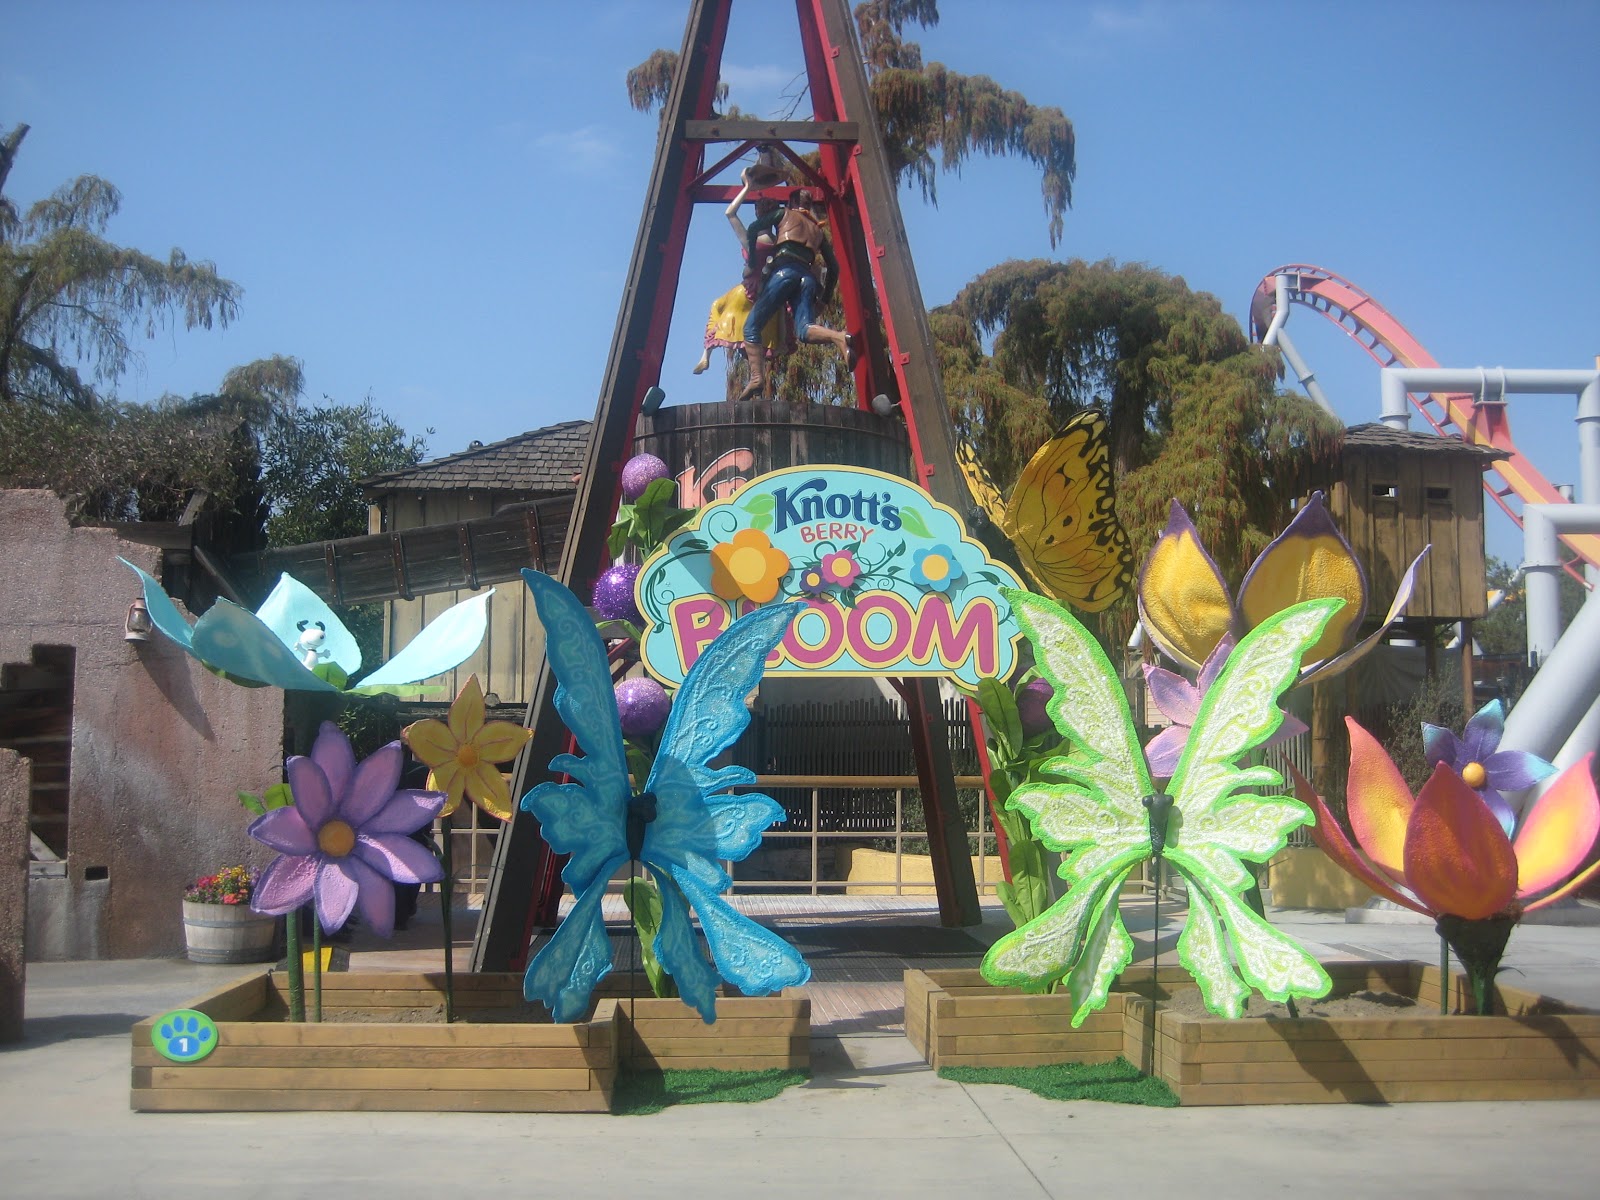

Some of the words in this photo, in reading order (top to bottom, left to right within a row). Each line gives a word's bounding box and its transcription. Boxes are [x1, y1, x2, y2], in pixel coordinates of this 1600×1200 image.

[771, 477, 902, 534] Knott's
[800, 522, 874, 543] BERRY
[670, 593, 998, 677] BOOM
[179, 1037, 188, 1053] 1
